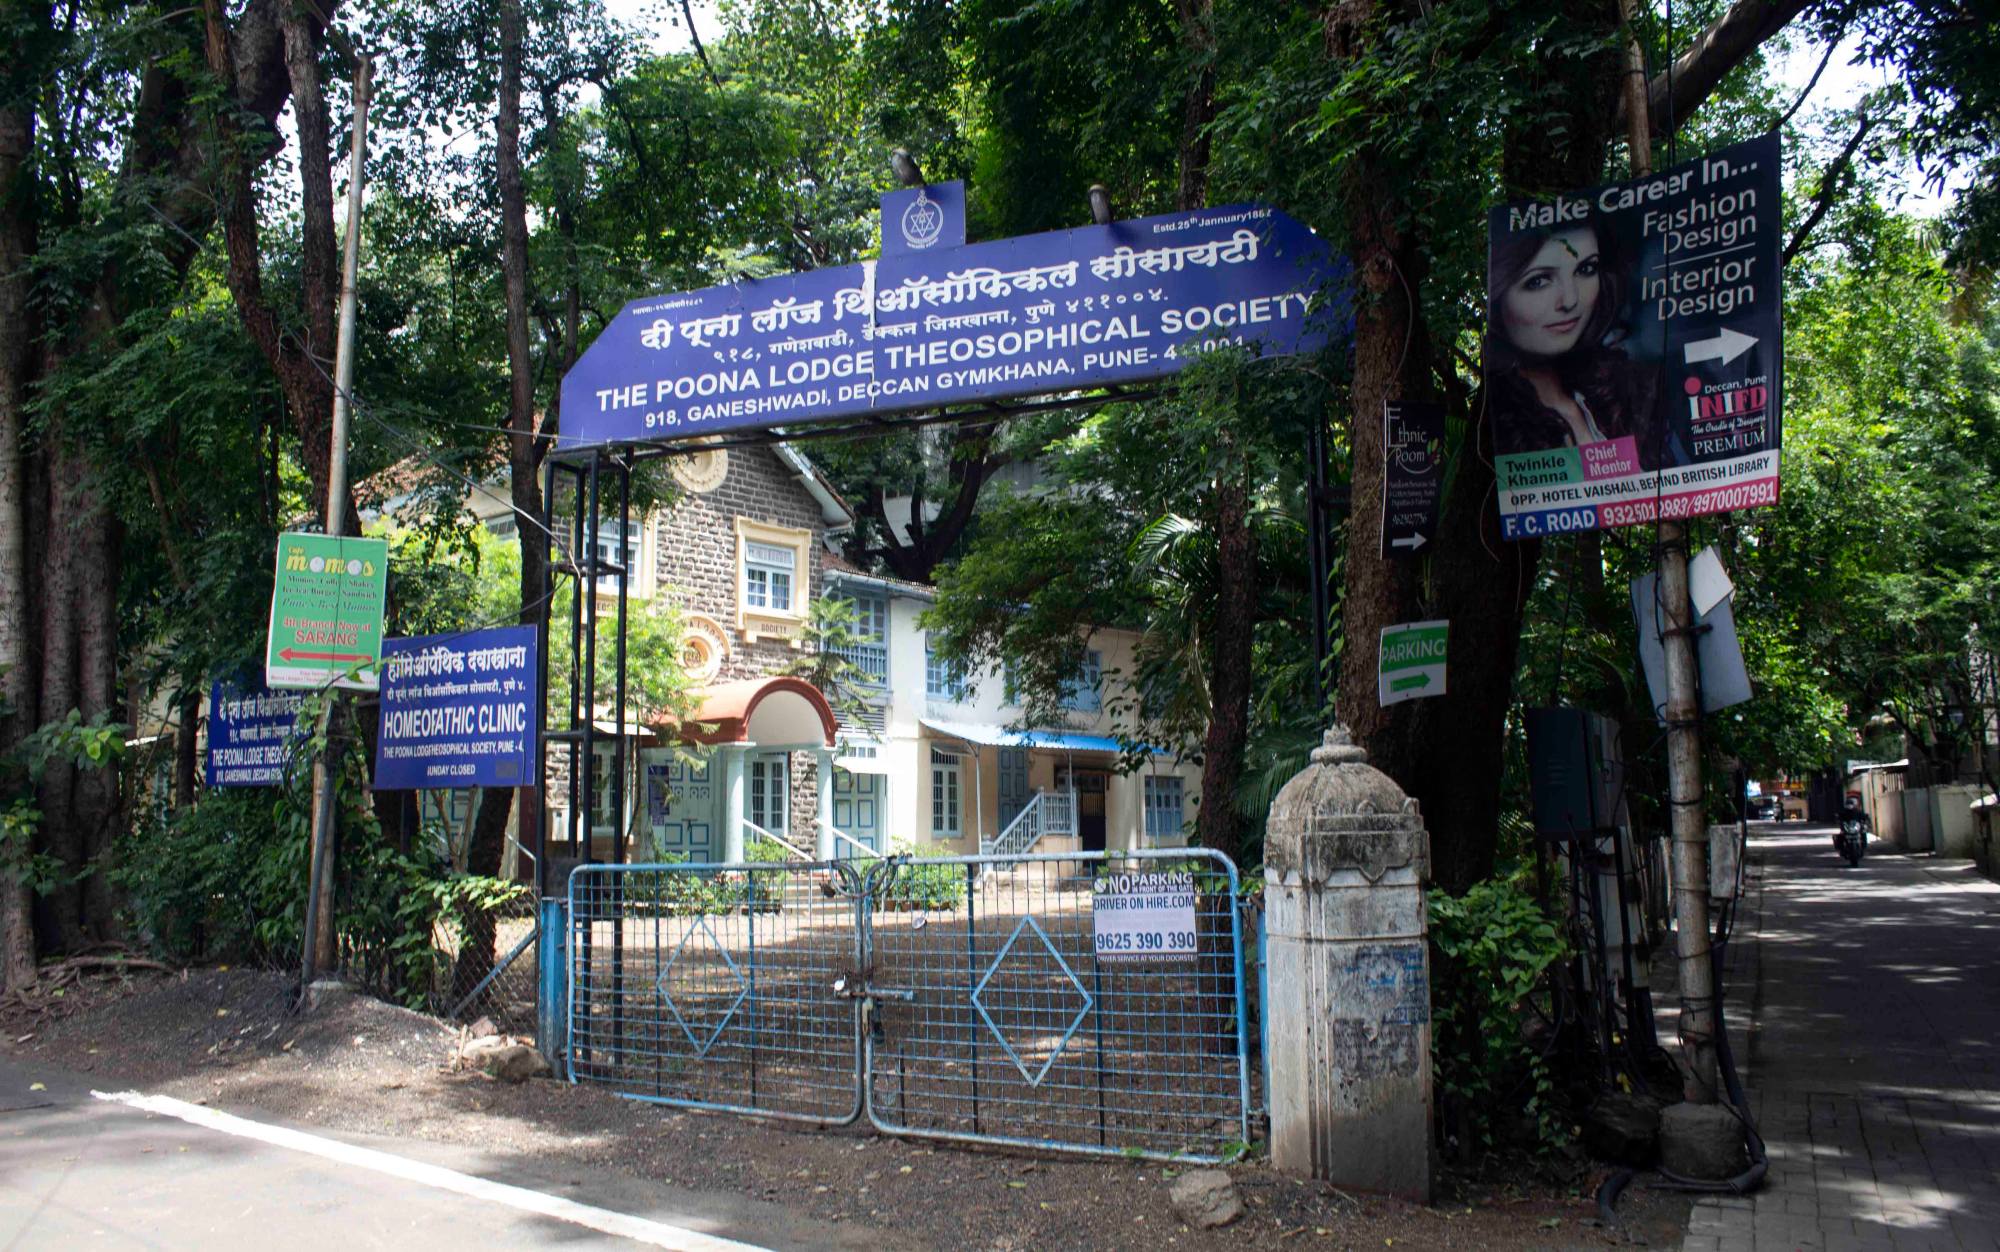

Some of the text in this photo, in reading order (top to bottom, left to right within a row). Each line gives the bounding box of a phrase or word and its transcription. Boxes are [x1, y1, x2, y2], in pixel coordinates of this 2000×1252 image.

[1509, 158, 1758, 232] Make Career In...
[1643, 189, 1756, 237] Fashion
[1663, 214, 1757, 256] Design
[1641, 256, 1757, 301] Interior
[1025, 299, 1055, 324] पुणे
[1657, 285, 1755, 320] Design
[640, 318, 674, 350] दी
[680, 314, 742, 347] पूना
[751, 297, 824, 333] लॉज
[596, 291, 1317, 411] THE POONA LODGE THEOSOPHICAL SOCIETY
[1744, 375, 1767, 387] Pune
[646, 411, 681, 428] 918,
[687, 388, 831, 422] GANESHWADI,
[838, 376, 928, 402] DECCAN
[937, 358, 1076, 390] GYMKHANA,
[1387, 408, 1427, 448] Ethnic
[1585, 444, 1617, 461] Chief
[1693, 429, 1765, 456] PREMIUM
[1395, 446, 1425, 468] Room
[1505, 456, 1566, 473] Twinkle
[1508, 471, 1568, 487] Khanna
[1590, 460, 1632, 477] Mentor
[1510, 457, 1770, 506] OPP. HOTEL VAISHALI, BEHIND BRITISH LIBRARY
[1546, 510, 1596, 532] ROAD
[301, 618, 335, 630] Branch
[338, 621, 358, 631] Now
[362, 623, 371, 632] at
[295, 629, 358, 647] SARANG
[1382, 638, 1446, 665] PARKING
[478, 702, 526, 734] CLINIC
[212, 748, 223, 767] THE
[224, 747, 243, 766] POONA
[243, 746, 263, 765] LODGE
[384, 747, 394, 759] THE
[395, 745, 413, 758] POONA
[498, 740, 514, 753] PUNE
[450, 764, 476, 776] CLOSED
[1109, 872, 1194, 894] NO PARKING
[1094, 895, 1194, 910] DRIVER ON HIRE.COM
[1096, 931, 1196, 950] 9625 390 390
